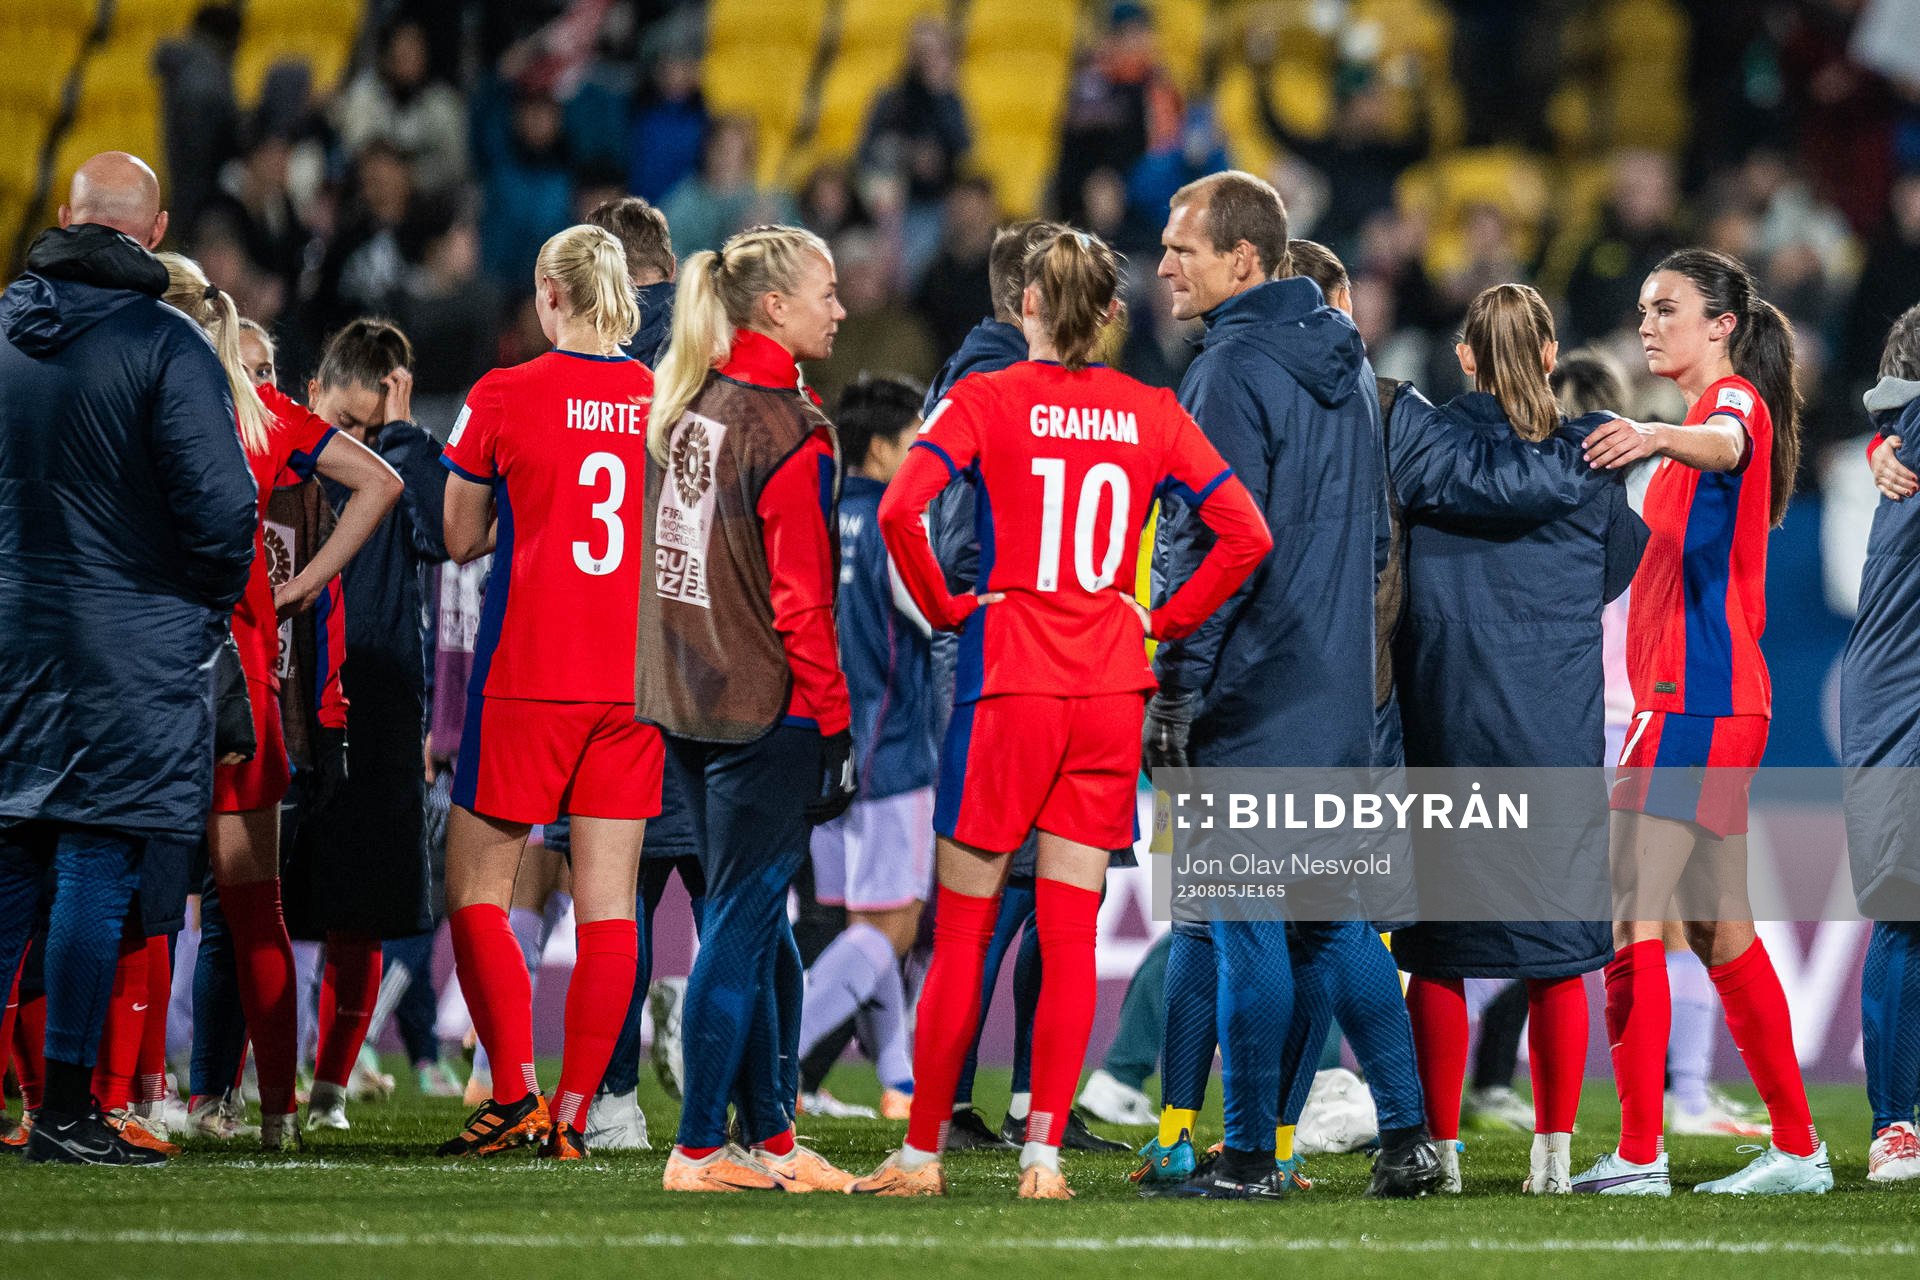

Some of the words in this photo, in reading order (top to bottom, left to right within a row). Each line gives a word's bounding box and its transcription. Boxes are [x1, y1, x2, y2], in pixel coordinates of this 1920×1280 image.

[567, 398, 641, 435] HØRTE
[1029, 404, 1139, 445] GRAHAM
[572, 451, 626, 576] 3
[1031, 457, 1130, 593] 10
